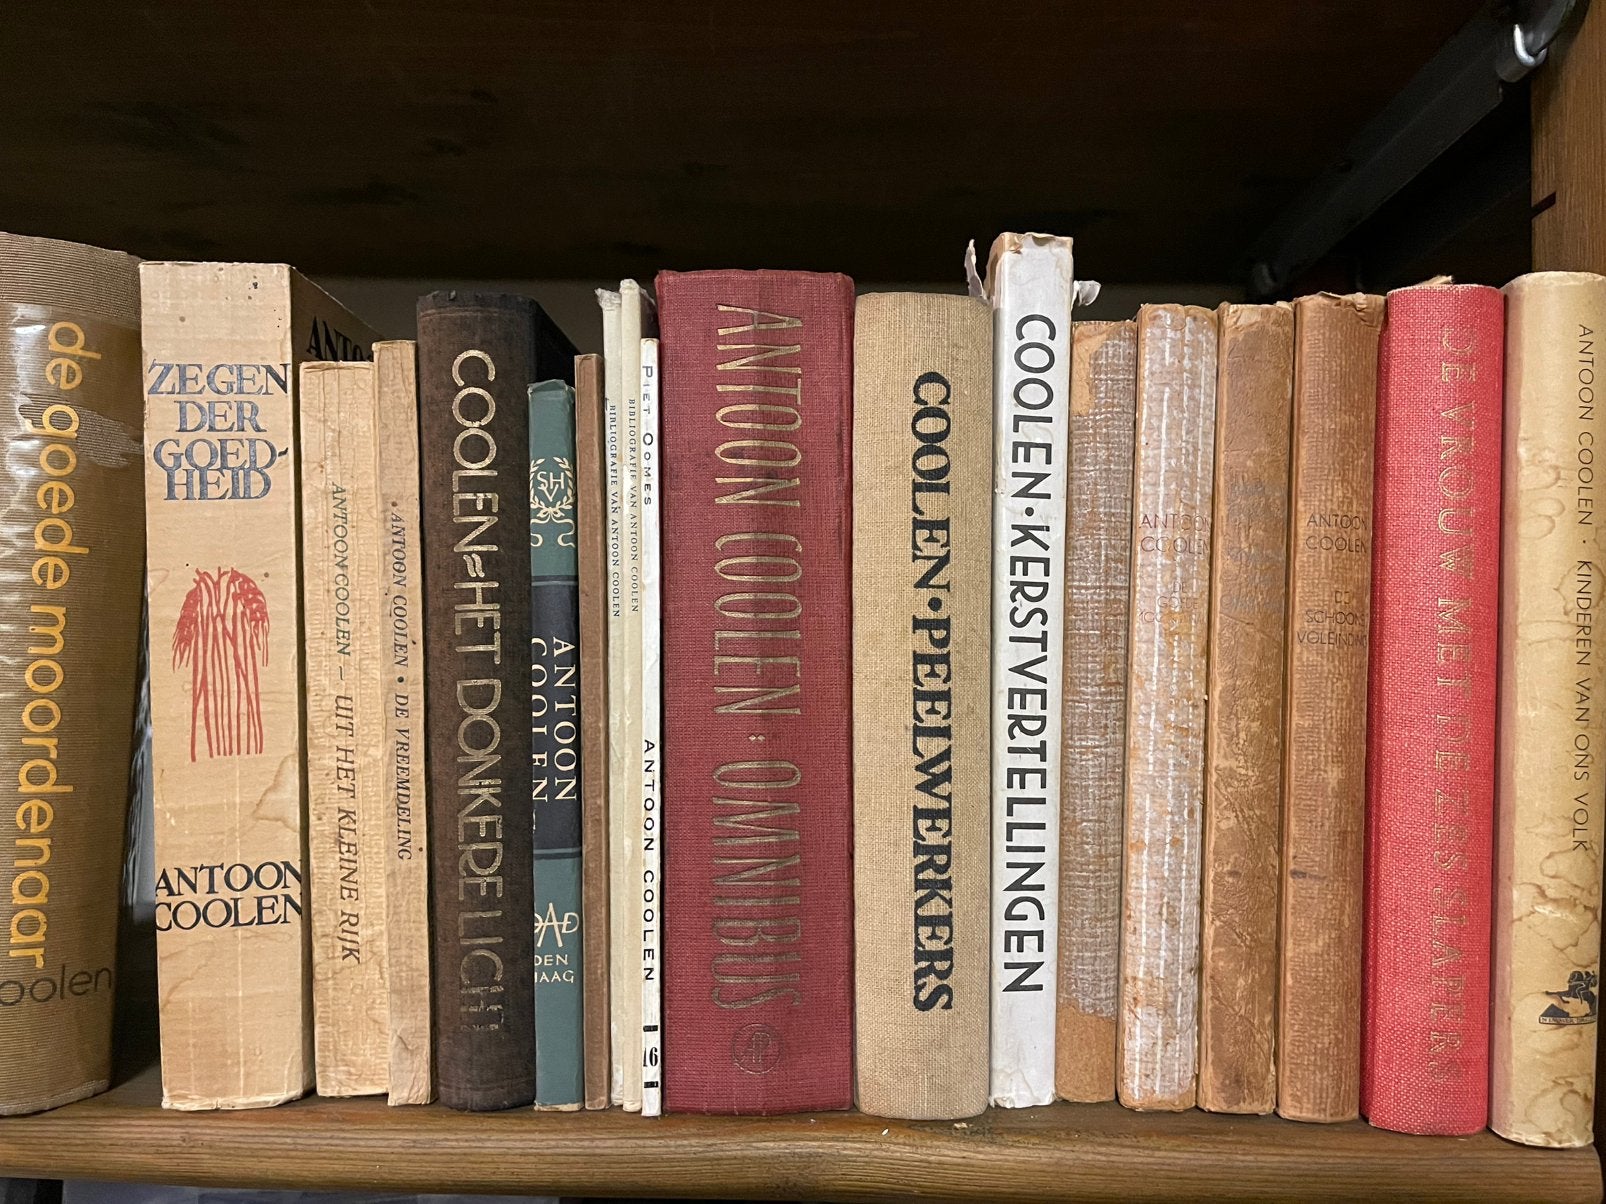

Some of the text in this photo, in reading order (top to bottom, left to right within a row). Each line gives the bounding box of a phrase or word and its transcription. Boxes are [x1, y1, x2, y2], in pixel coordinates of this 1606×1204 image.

[148, 359, 291, 395] ZEGEN
[1440, 328, 1476, 384] DE
[174, 400, 267, 433] DER
[714, 304, 802, 507] ANTOON
[153, 438, 289, 471] GOED-
[163, 468, 272, 501] HEID
[452, 350, 498, 552] COOLEN
[642, 432, 654, 505] OOMES
[1438, 402, 1476, 580] VROUW
[332, 482, 349, 571] ANTOON
[611, 491, 619, 514] VAN
[611, 519, 620, 566] ANTOON
[628, 399, 639, 612] BIBLIOGRAFIE VAN ANTOON COOLEN
[1305, 535, 1367, 553] COOLEN
[1306, 513, 1367, 531] ANTOON
[334, 573, 351, 657] COOLEN
[454, 582, 500, 665] HET
[612, 572, 620, 617] COOLEN
[713, 532, 803, 715] COOLEN
[1571, 324, 1594, 852] ANTOON COOLEN KINDEREN VAN ONS VOLK
[9, 321, 101, 969] de goede moordenaar
[391, 512, 412, 861] ANTOON COOLEN DE VREEMDELING
[1002, 314, 1057, 993] COOLEN KERSTVERTELLINGEN
[1436, 597, 1473, 700] MET
[335, 693, 354, 738] UIT
[553, 637, 577, 801] ANTOON
[911, 371, 954, 1012] COOLEN PEELWERKERS
[335, 746, 356, 800] HET
[1435, 714, 1471, 772] DE
[456, 679, 503, 901] DONKERE
[155, 861, 302, 897] ANTOON
[337, 806, 359, 900] KLEINE
[643, 740, 656, 981] ANTOON COOLEN
[711, 760, 802, 1010] OMNIBUS
[155, 894, 302, 932] COOLEN
[337, 910, 361, 964] RIJK
